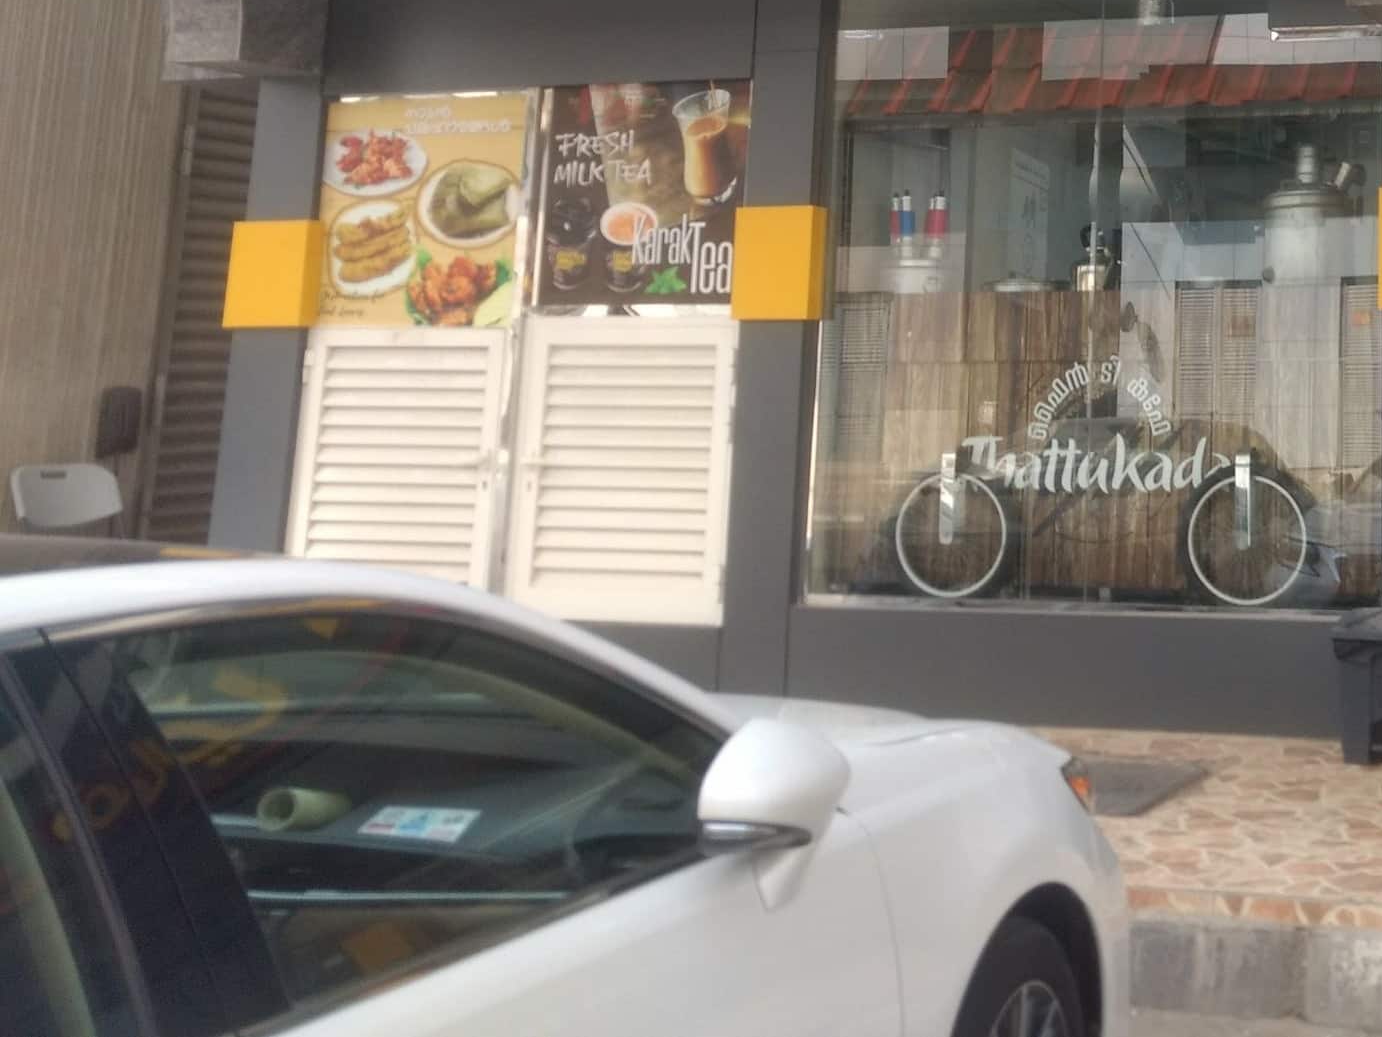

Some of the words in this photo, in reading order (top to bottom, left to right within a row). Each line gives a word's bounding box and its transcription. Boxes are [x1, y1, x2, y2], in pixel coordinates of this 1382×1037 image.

[555, 129, 636, 158] FRESH
[553, 160, 605, 188] MILK
[607, 159, 652, 186] TEA
[631, 214, 693, 265] Karak
[689, 222, 734, 294] Tea
